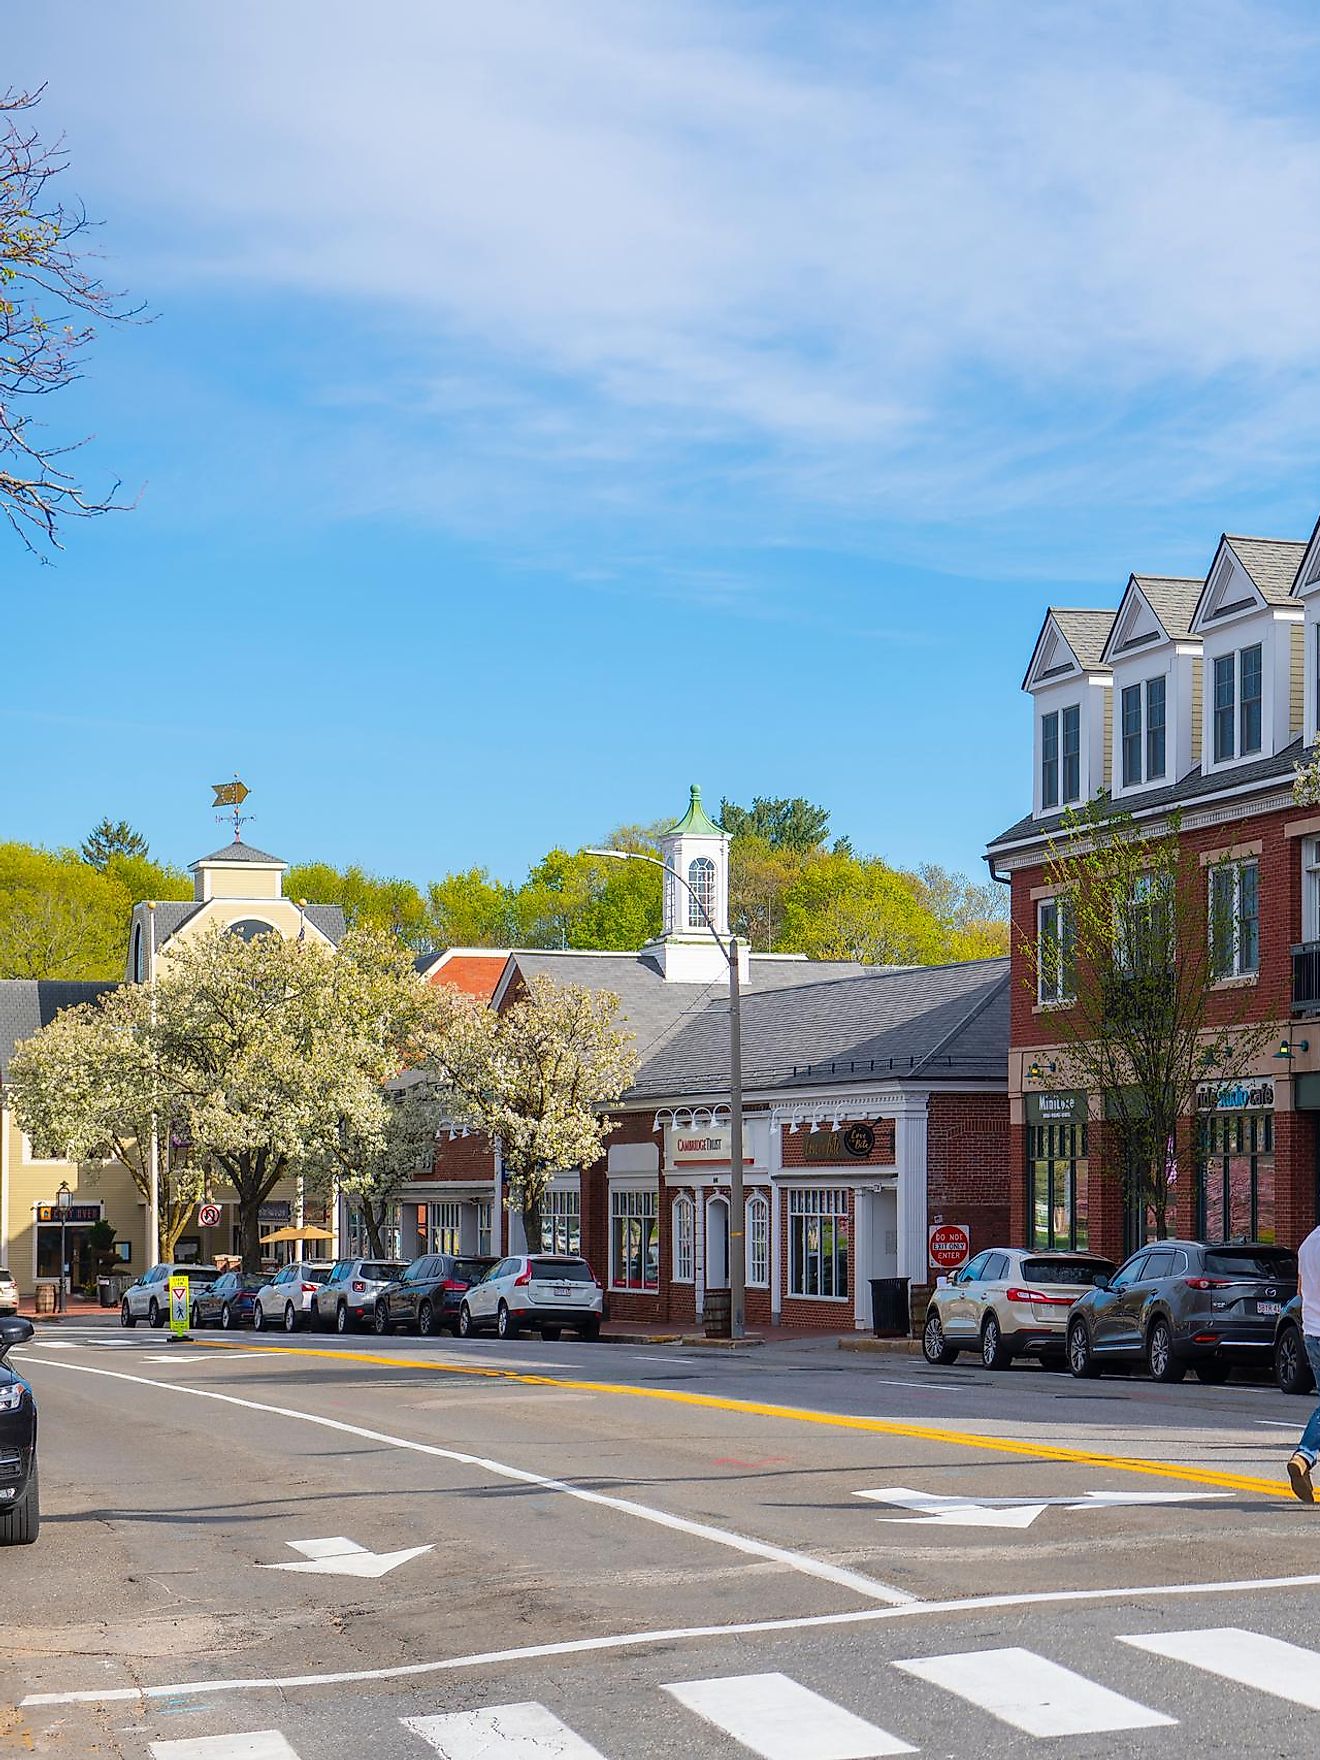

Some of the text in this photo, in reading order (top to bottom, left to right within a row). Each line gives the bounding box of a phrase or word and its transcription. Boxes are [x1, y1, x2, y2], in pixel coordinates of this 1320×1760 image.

[1039, 1094, 1075, 1110] MiniLuxe
[936, 1232, 963, 1241] DO NOT
